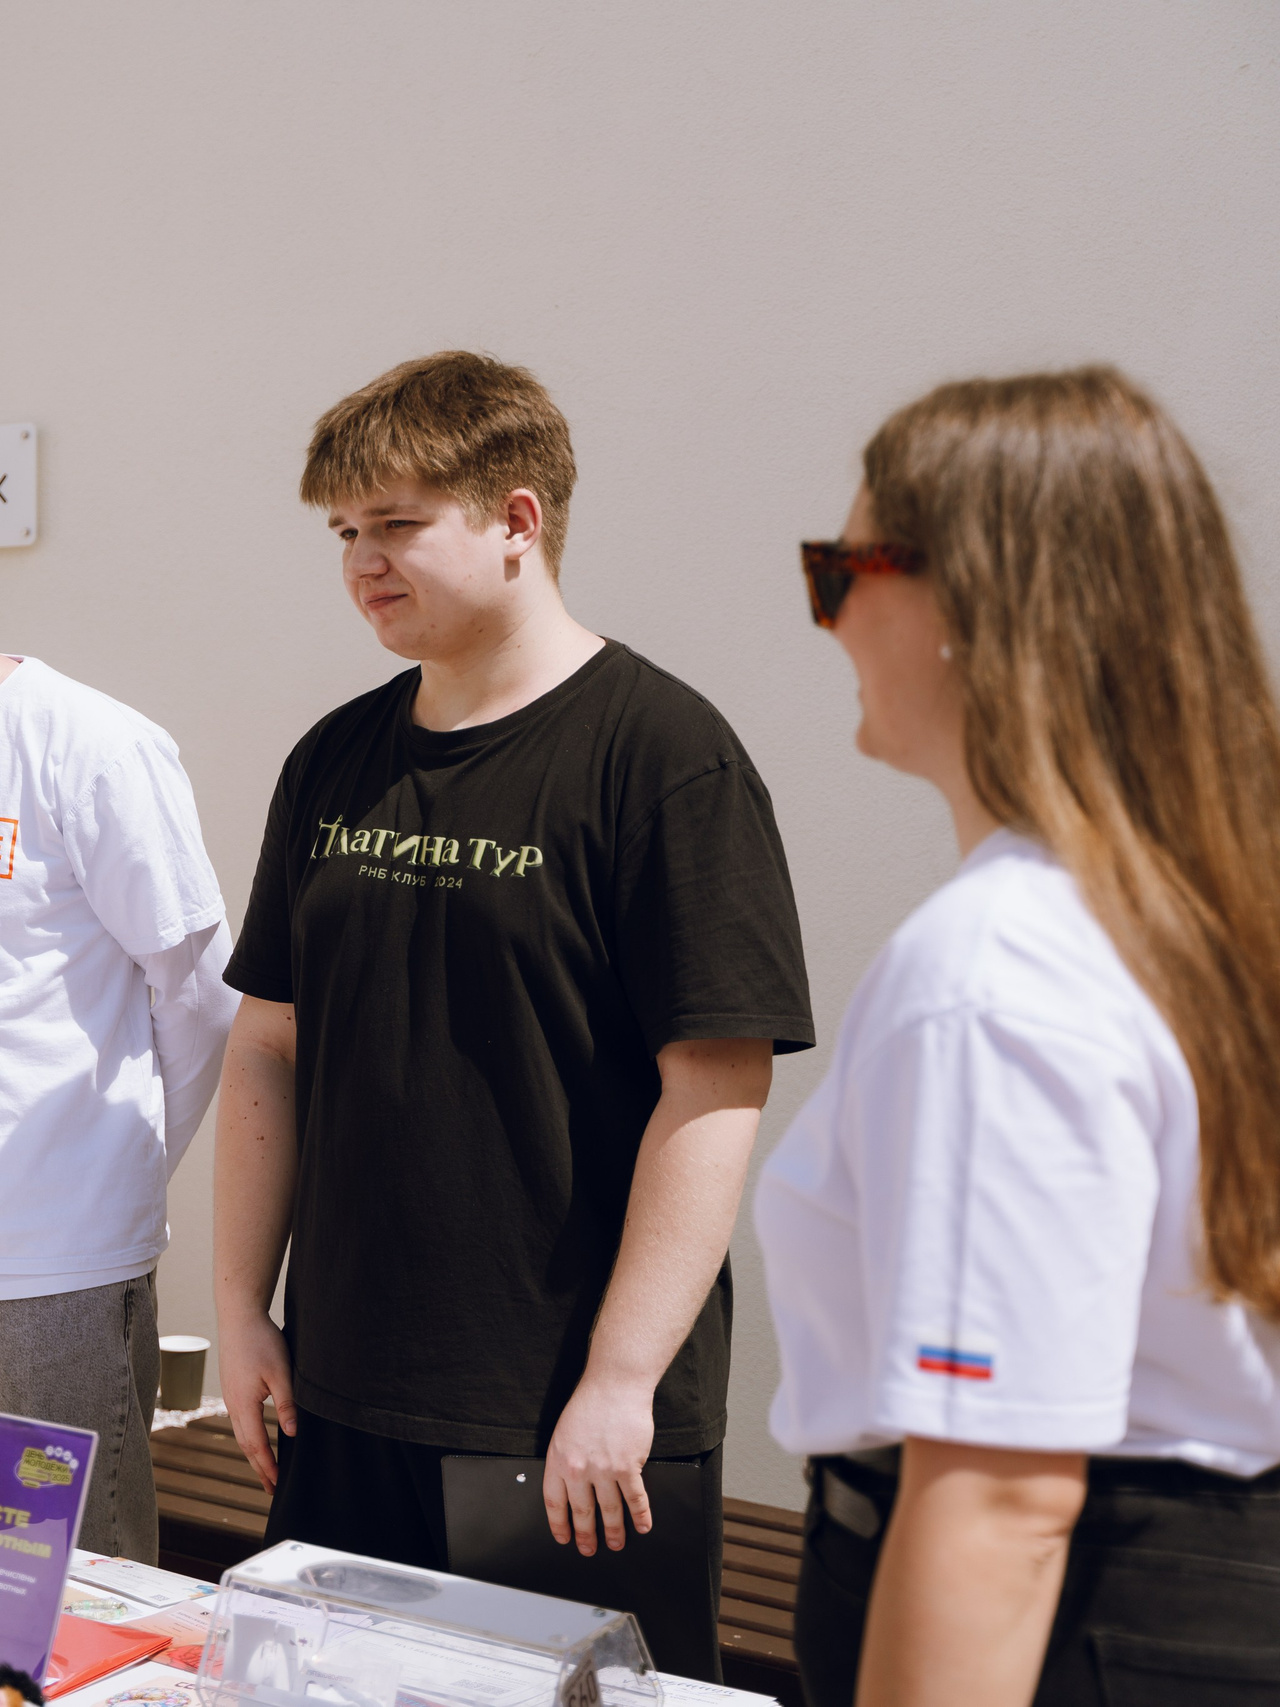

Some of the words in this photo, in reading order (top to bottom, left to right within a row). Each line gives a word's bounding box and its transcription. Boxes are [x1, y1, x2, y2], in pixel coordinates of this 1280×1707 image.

[358, 864, 388, 880] РНБ
[391, 870, 427, 887] КЛУБ
[51, 1473, 70, 1483] 2025
